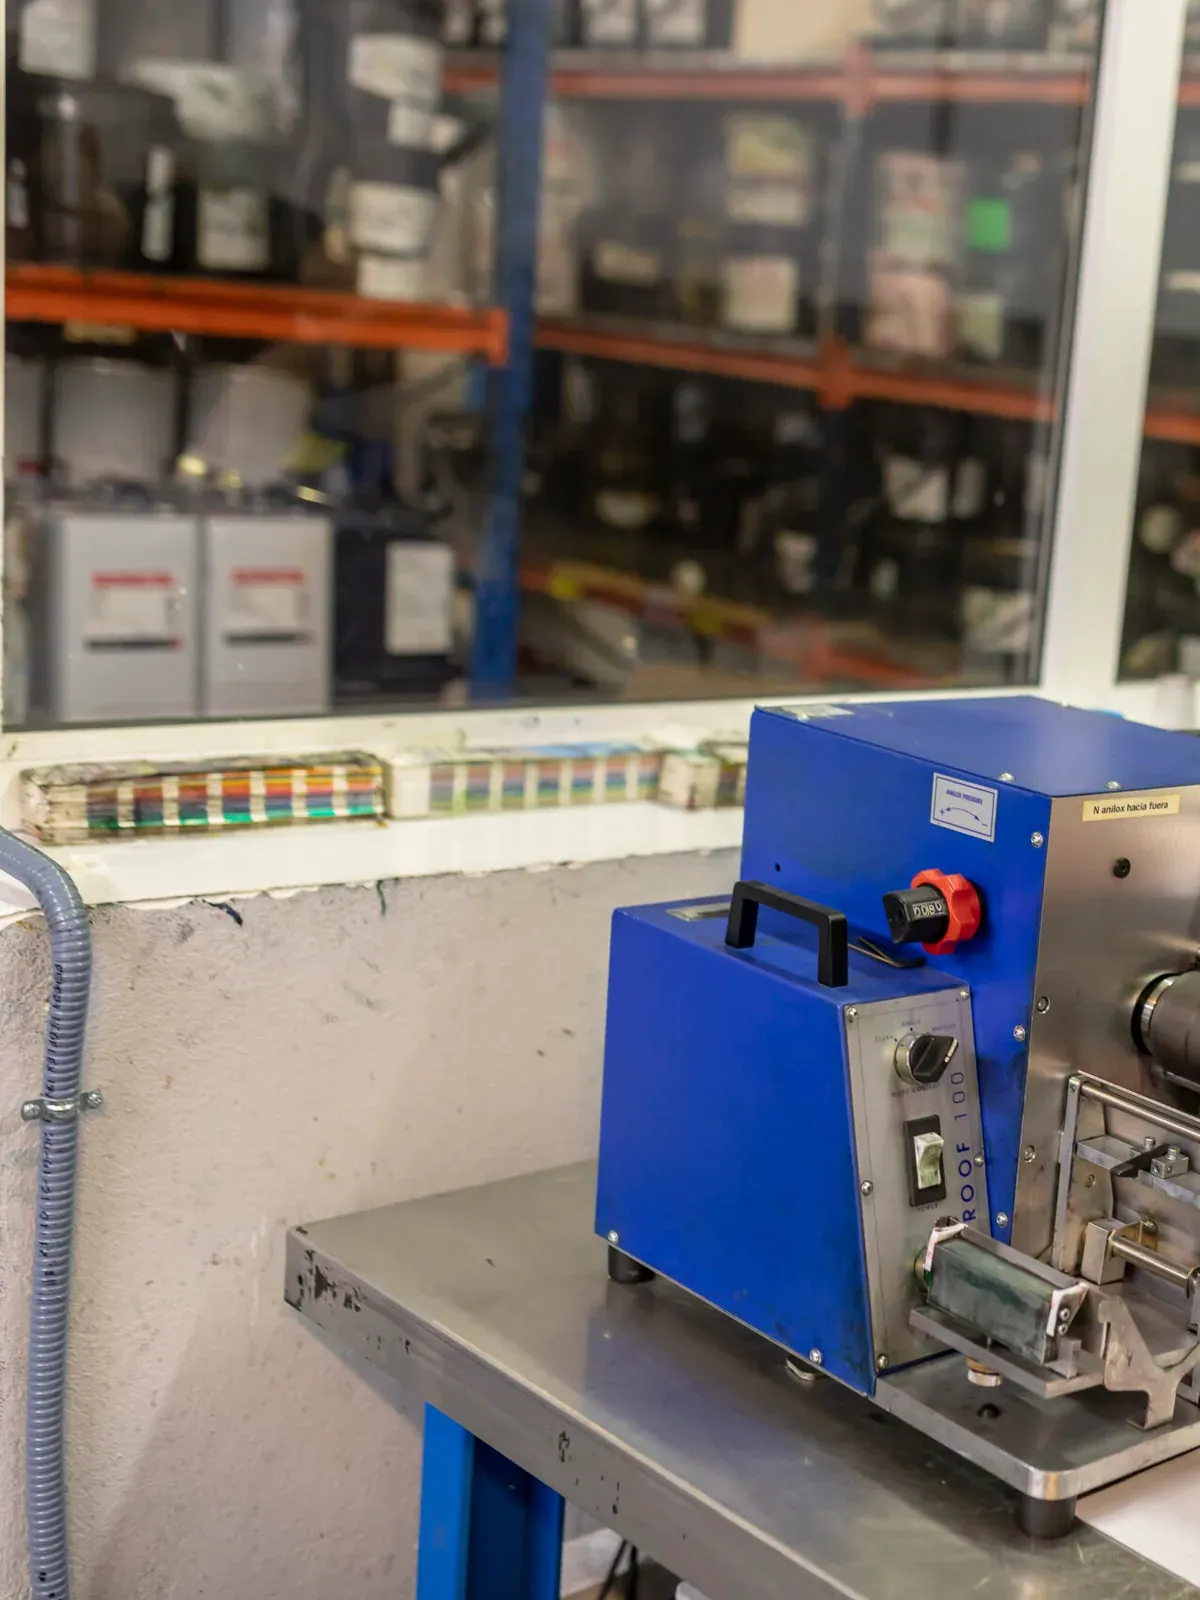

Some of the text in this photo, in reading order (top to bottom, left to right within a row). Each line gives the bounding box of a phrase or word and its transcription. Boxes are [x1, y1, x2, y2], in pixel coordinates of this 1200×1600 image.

[1093, 801, 1169, 815] N anilox hacia fuera
[956, 1142, 977, 1223] ROOF
